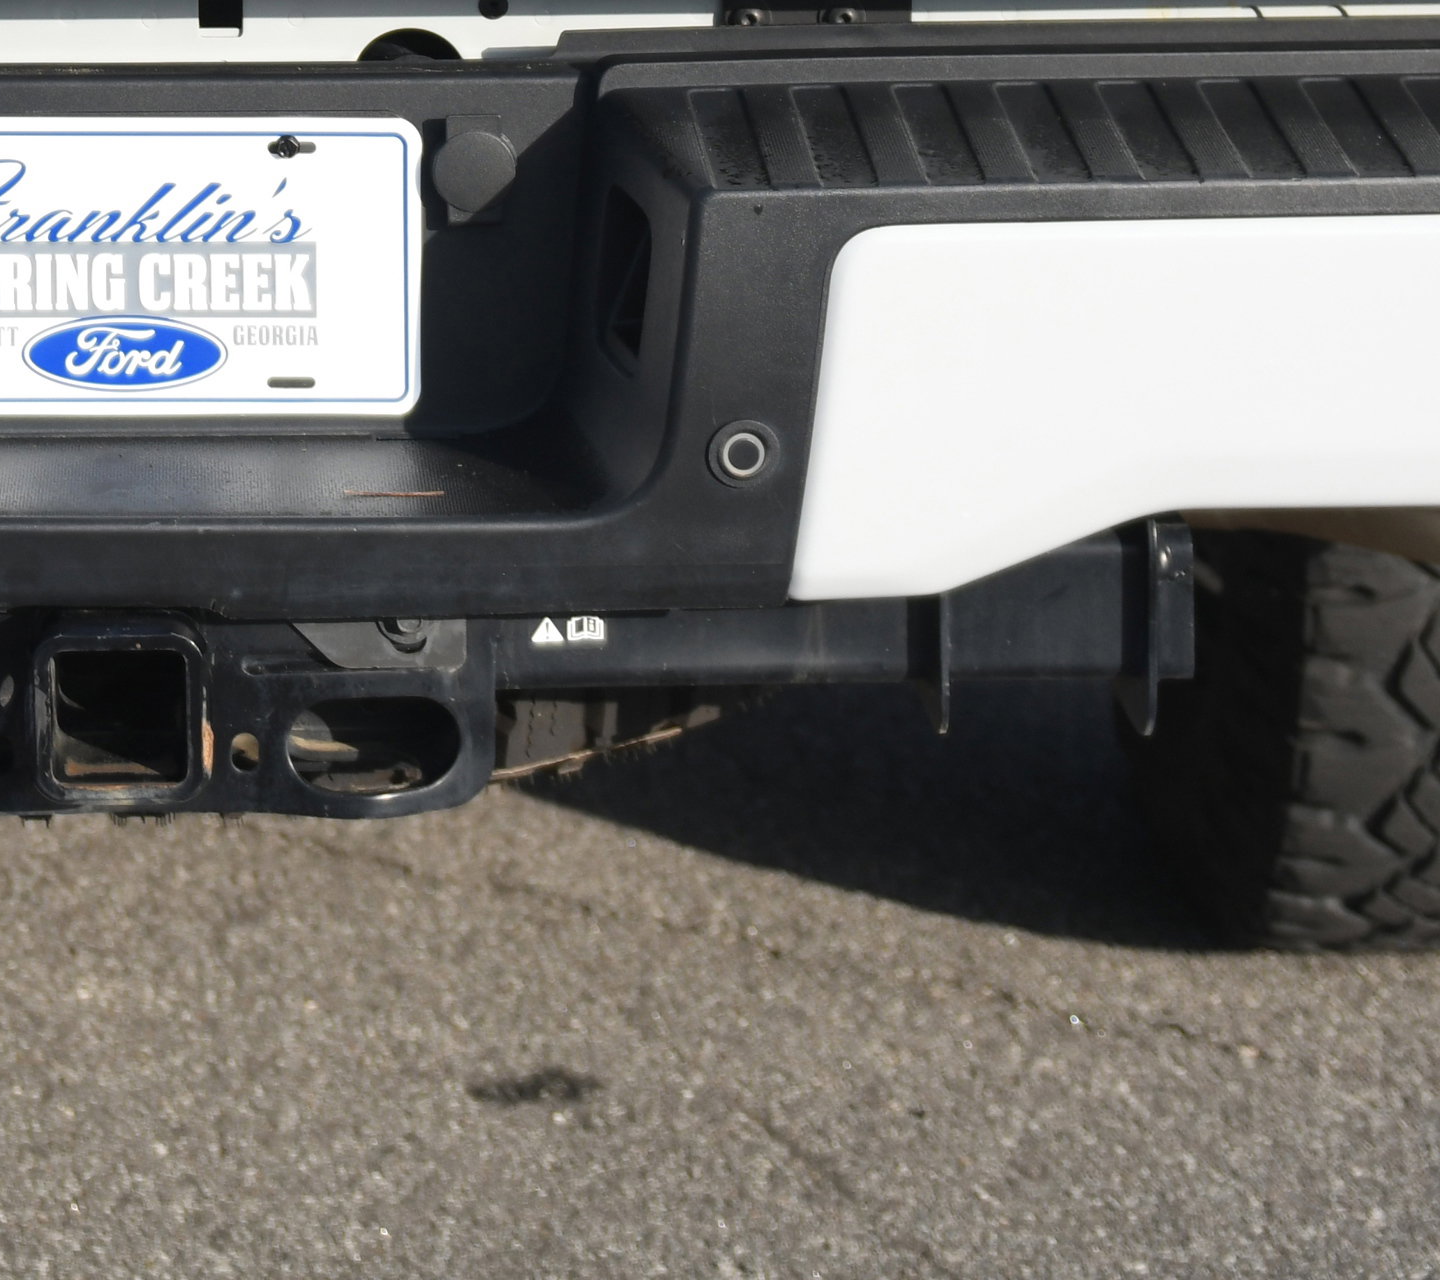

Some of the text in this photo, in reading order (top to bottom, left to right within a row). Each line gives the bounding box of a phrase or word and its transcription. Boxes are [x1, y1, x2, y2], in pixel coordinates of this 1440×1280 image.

[138, 252, 313, 312] CREEK
[65, 326, 184, 377] Ford
[232, 324, 319, 347] GEORGIA
